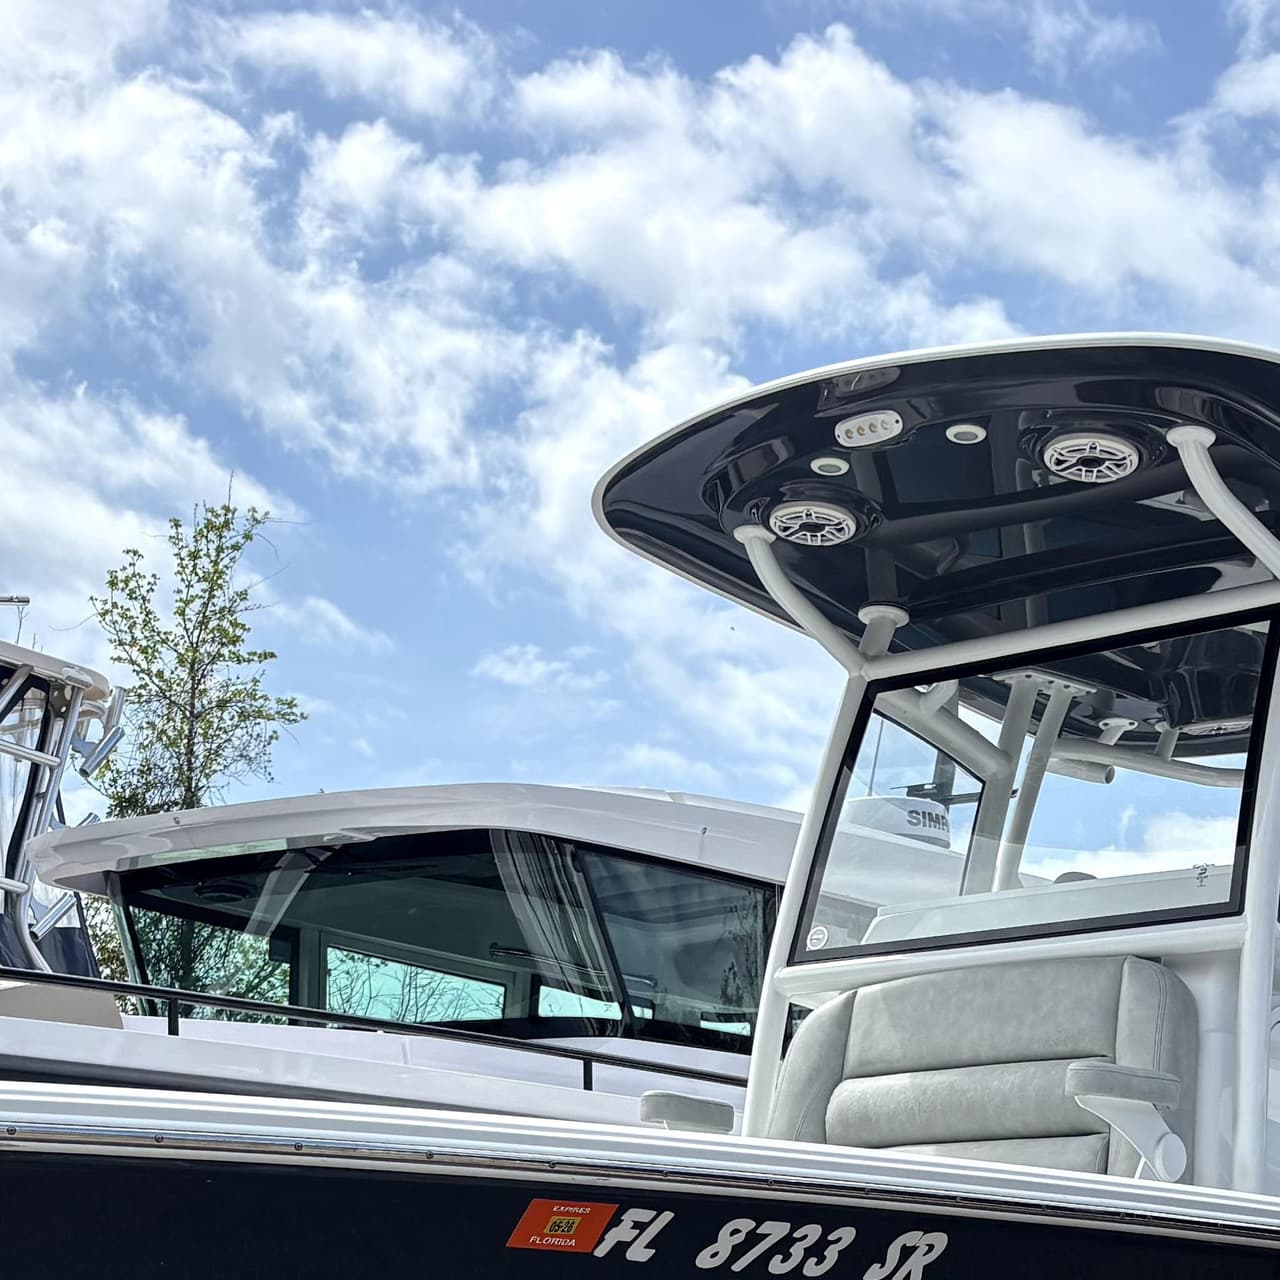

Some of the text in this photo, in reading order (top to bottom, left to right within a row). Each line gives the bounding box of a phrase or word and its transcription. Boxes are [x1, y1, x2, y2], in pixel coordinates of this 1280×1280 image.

[529, 1235, 577, 1247] FLORIDA
[593, 1207, 675, 1263] FL
[695, 1217, 857, 1278] 8733
